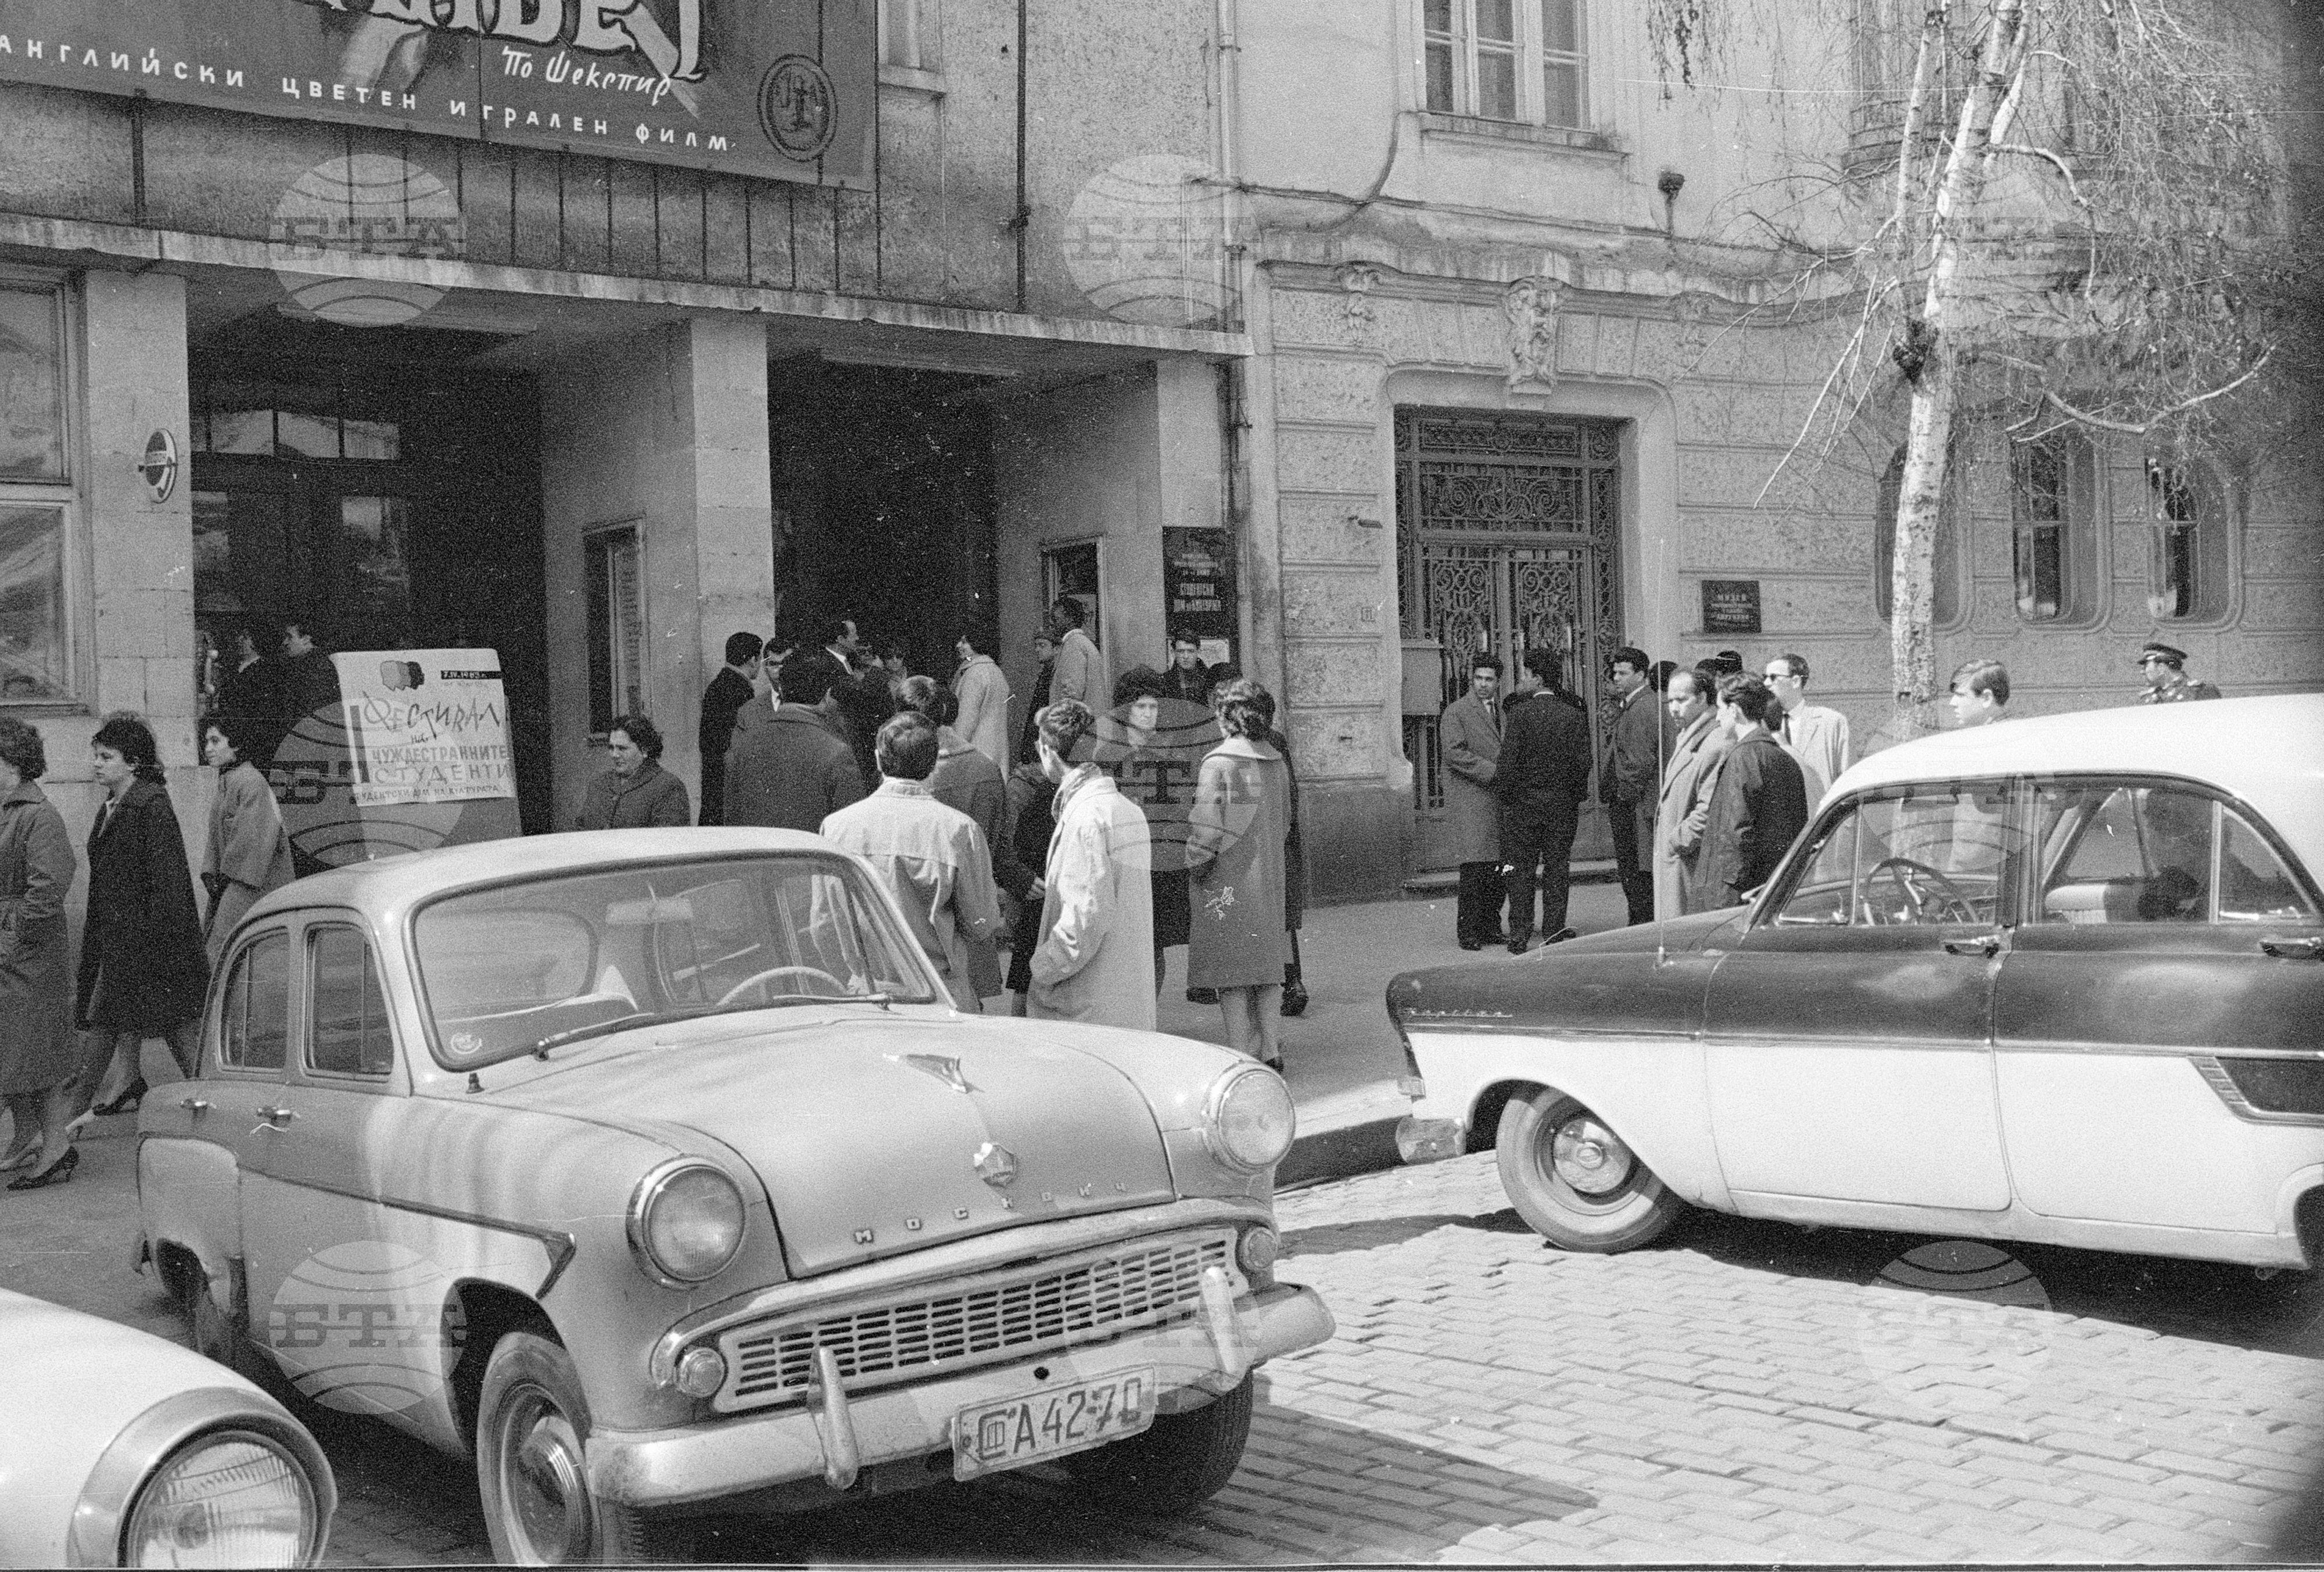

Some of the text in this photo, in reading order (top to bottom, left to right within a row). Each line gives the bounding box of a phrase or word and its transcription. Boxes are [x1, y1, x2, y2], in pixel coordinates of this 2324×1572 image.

[0, 35, 727, 151] АНГЛИЙСКИ ЦВЕТЕН ИГРАЛЕН ФИЛМ
[502, 46, 671, 106] По Шекспир
[372, 744, 507, 765] ЧУЖДЕСТРАННИТЕ
[375, 765, 509, 786] СТУДЕНТИ
